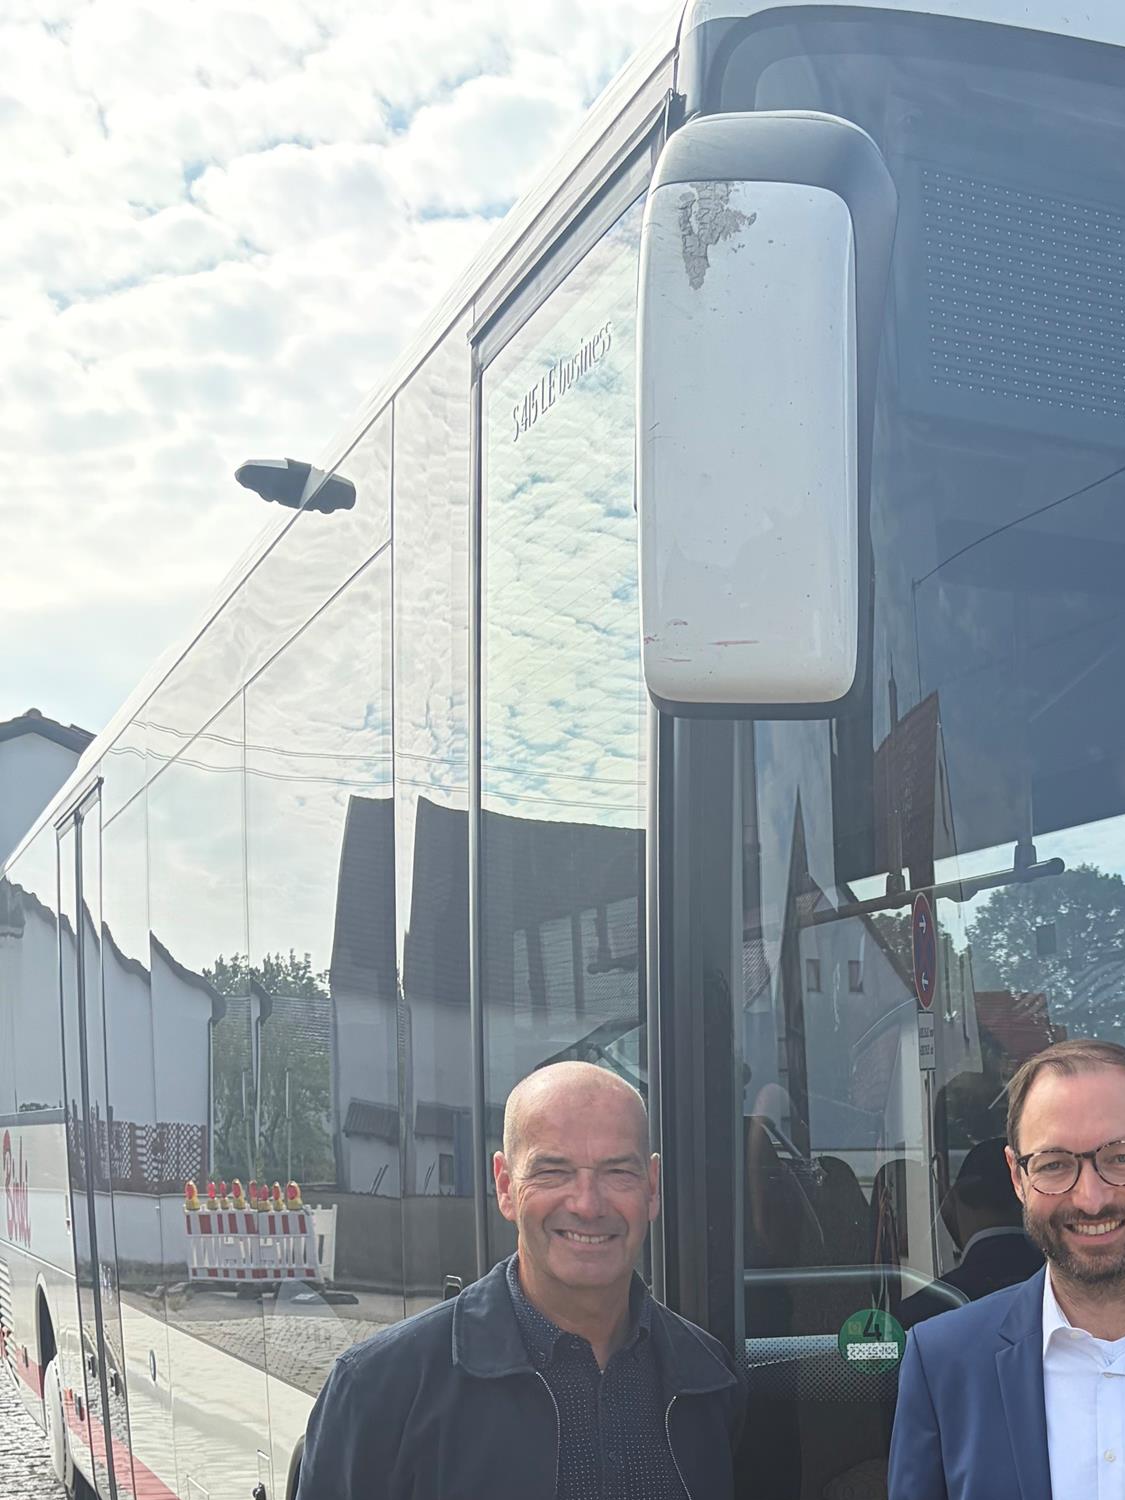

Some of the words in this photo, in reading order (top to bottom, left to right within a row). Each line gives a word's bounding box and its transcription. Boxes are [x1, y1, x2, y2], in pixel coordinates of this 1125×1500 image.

[541, 364, 557, 415] LE
[559, 321, 613, 396] business
[863, 1311, 882, 1342] 4
